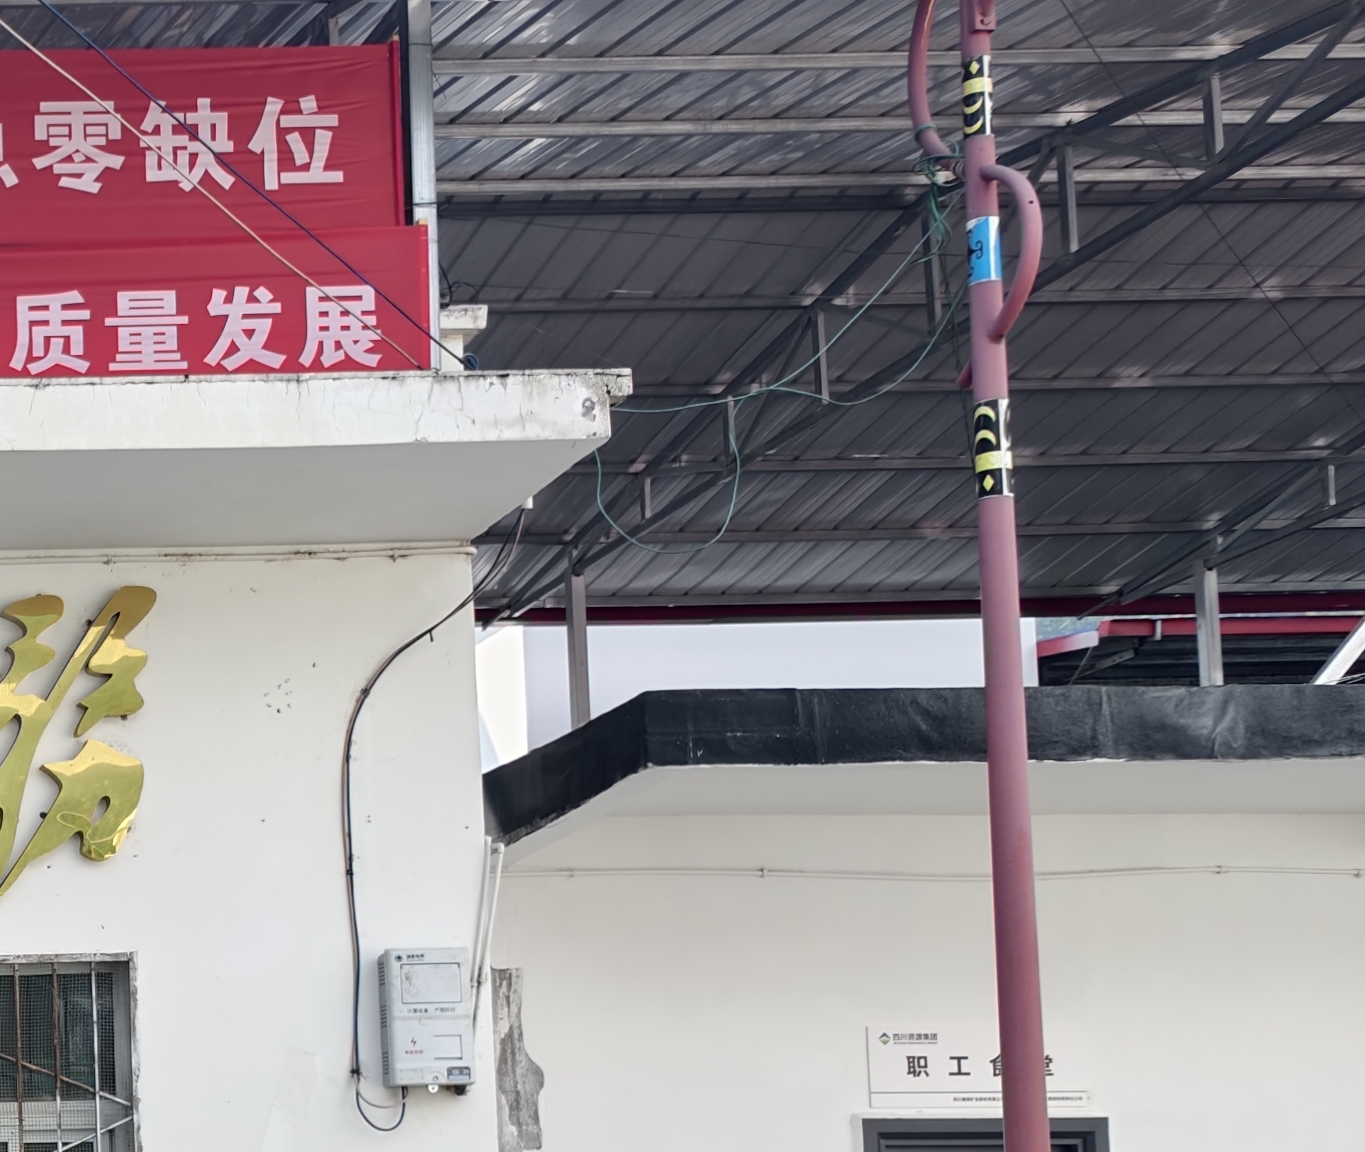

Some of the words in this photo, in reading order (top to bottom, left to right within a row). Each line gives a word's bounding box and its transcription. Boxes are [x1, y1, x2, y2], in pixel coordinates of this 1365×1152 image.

[892, 1032, 938, 1042] 四川资源集团
